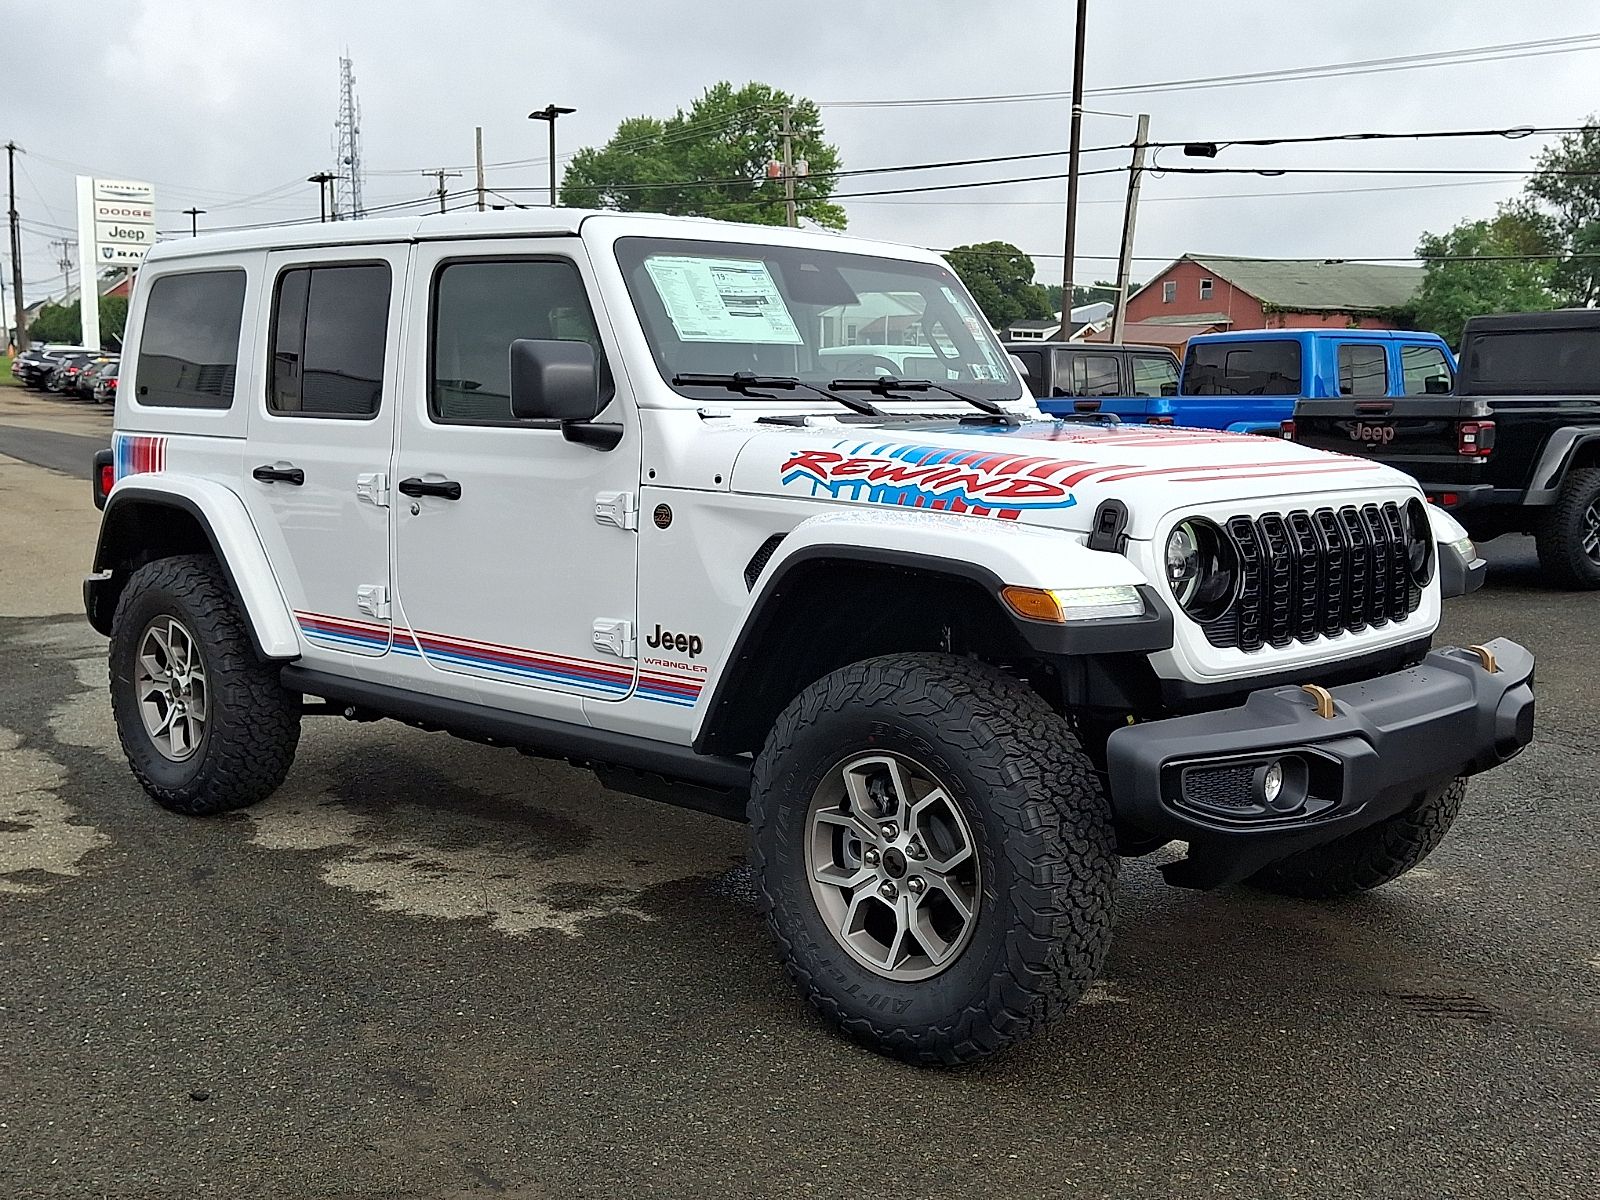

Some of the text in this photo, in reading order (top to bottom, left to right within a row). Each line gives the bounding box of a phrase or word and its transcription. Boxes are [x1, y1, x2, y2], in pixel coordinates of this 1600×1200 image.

[100, 207, 152, 217] DODGE
[109, 226, 145, 241] Jeep
[1350, 422, 1394, 444] Jeep
[780, 450, 1065, 497] REWIND
[646, 623, 703, 658] Jeep
